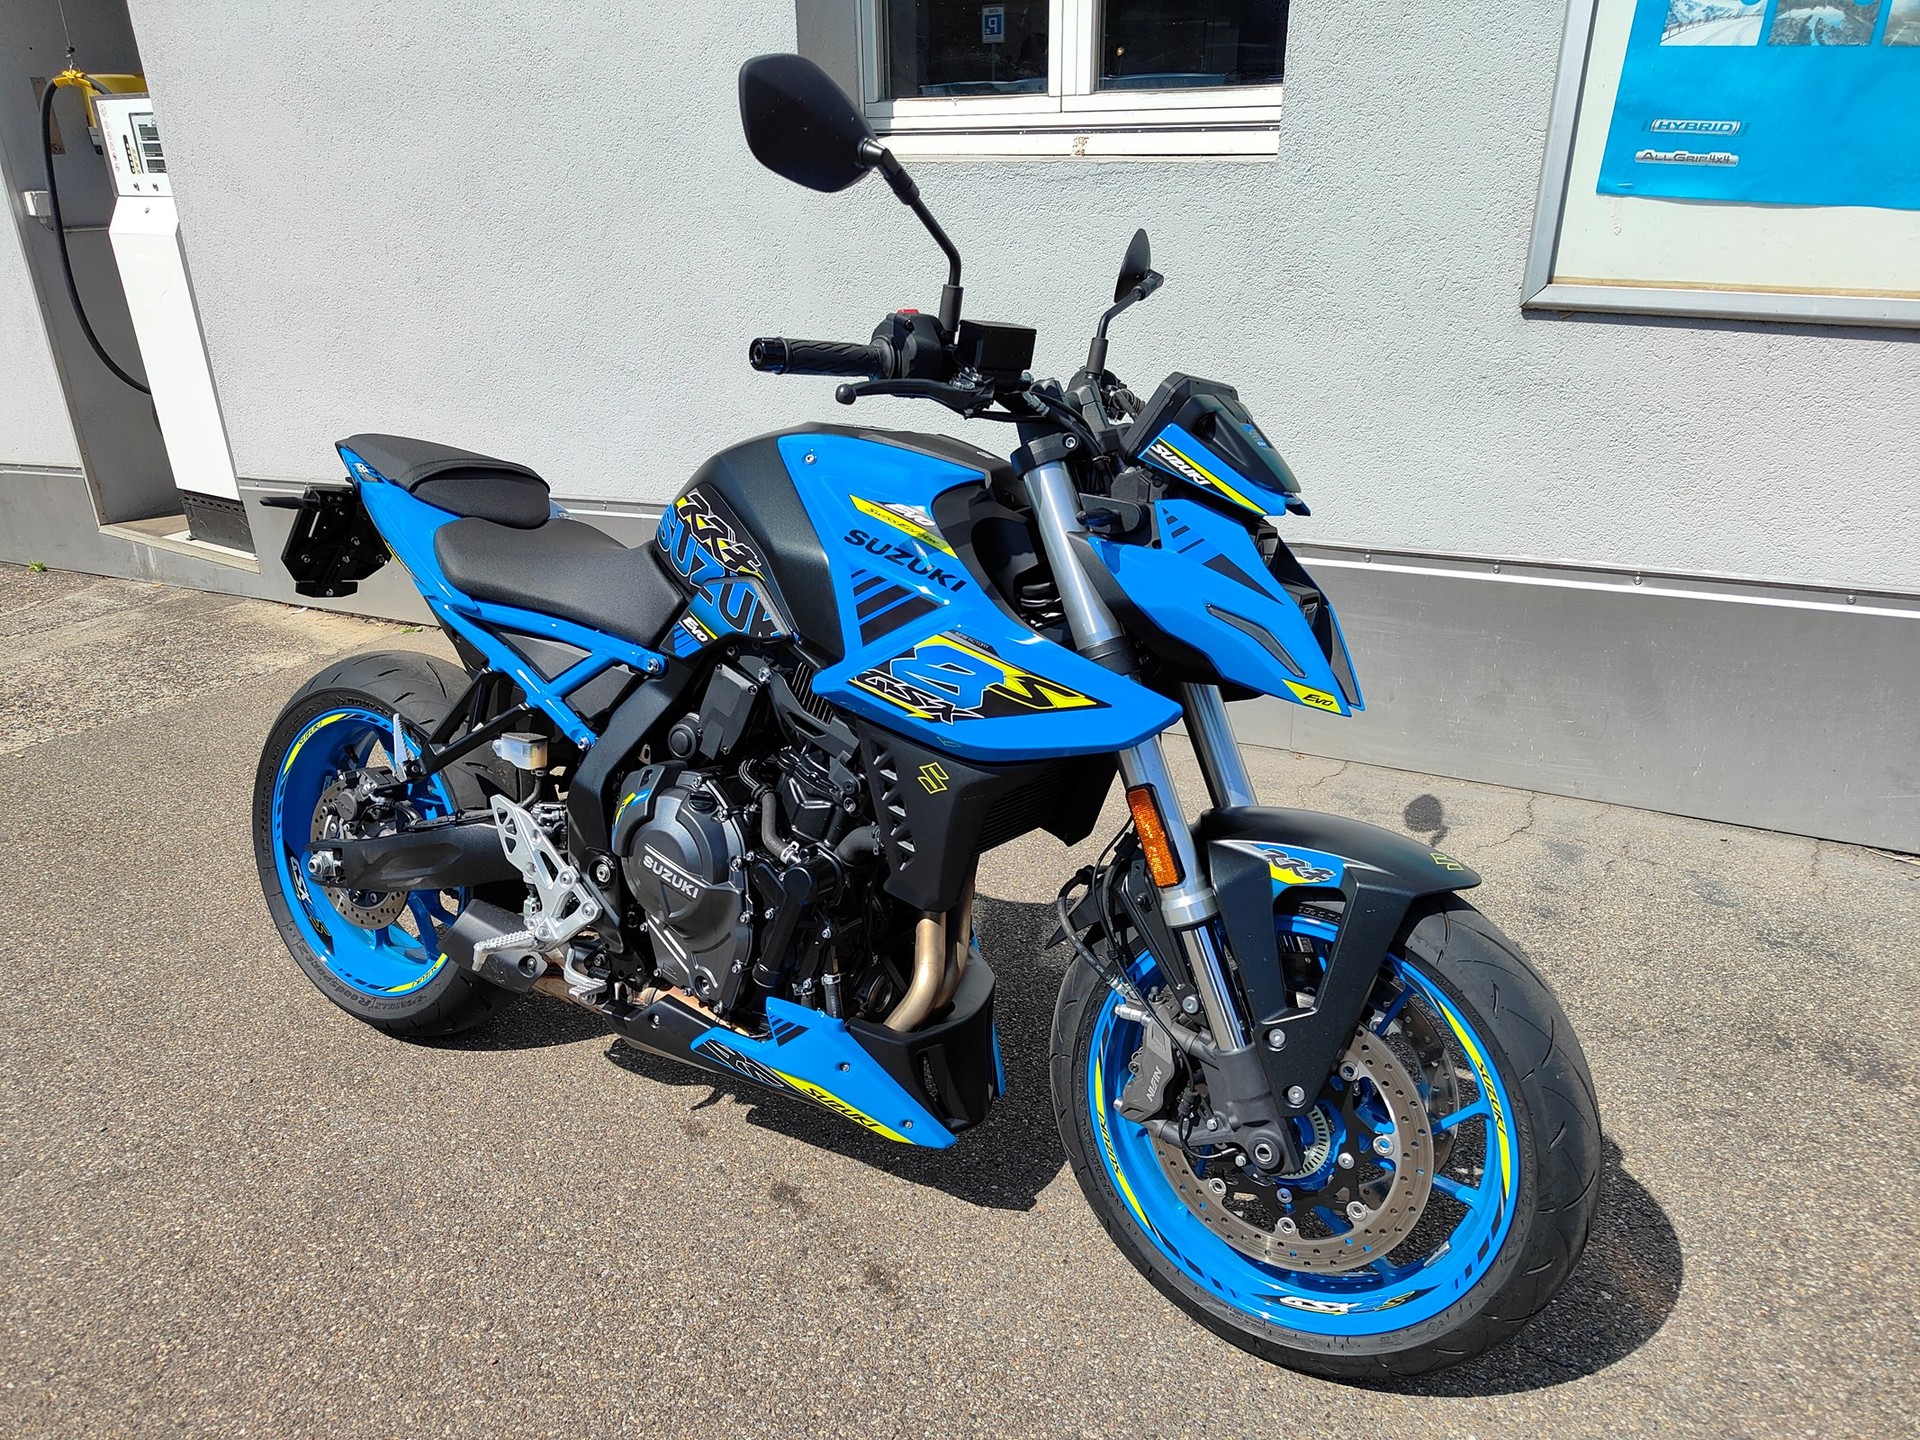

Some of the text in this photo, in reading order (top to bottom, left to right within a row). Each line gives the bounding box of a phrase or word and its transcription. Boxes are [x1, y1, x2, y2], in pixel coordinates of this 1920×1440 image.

[1657, 120, 1735, 132] HYBRID
[1150, 443, 1212, 487] SUZUKI
[844, 529, 967, 593] SUZUKI
[642, 854, 699, 899] SUZUKI
[803, 1087, 881, 1128] SUZUKI
[1475, 1058, 1507, 1136] SUZUKI
